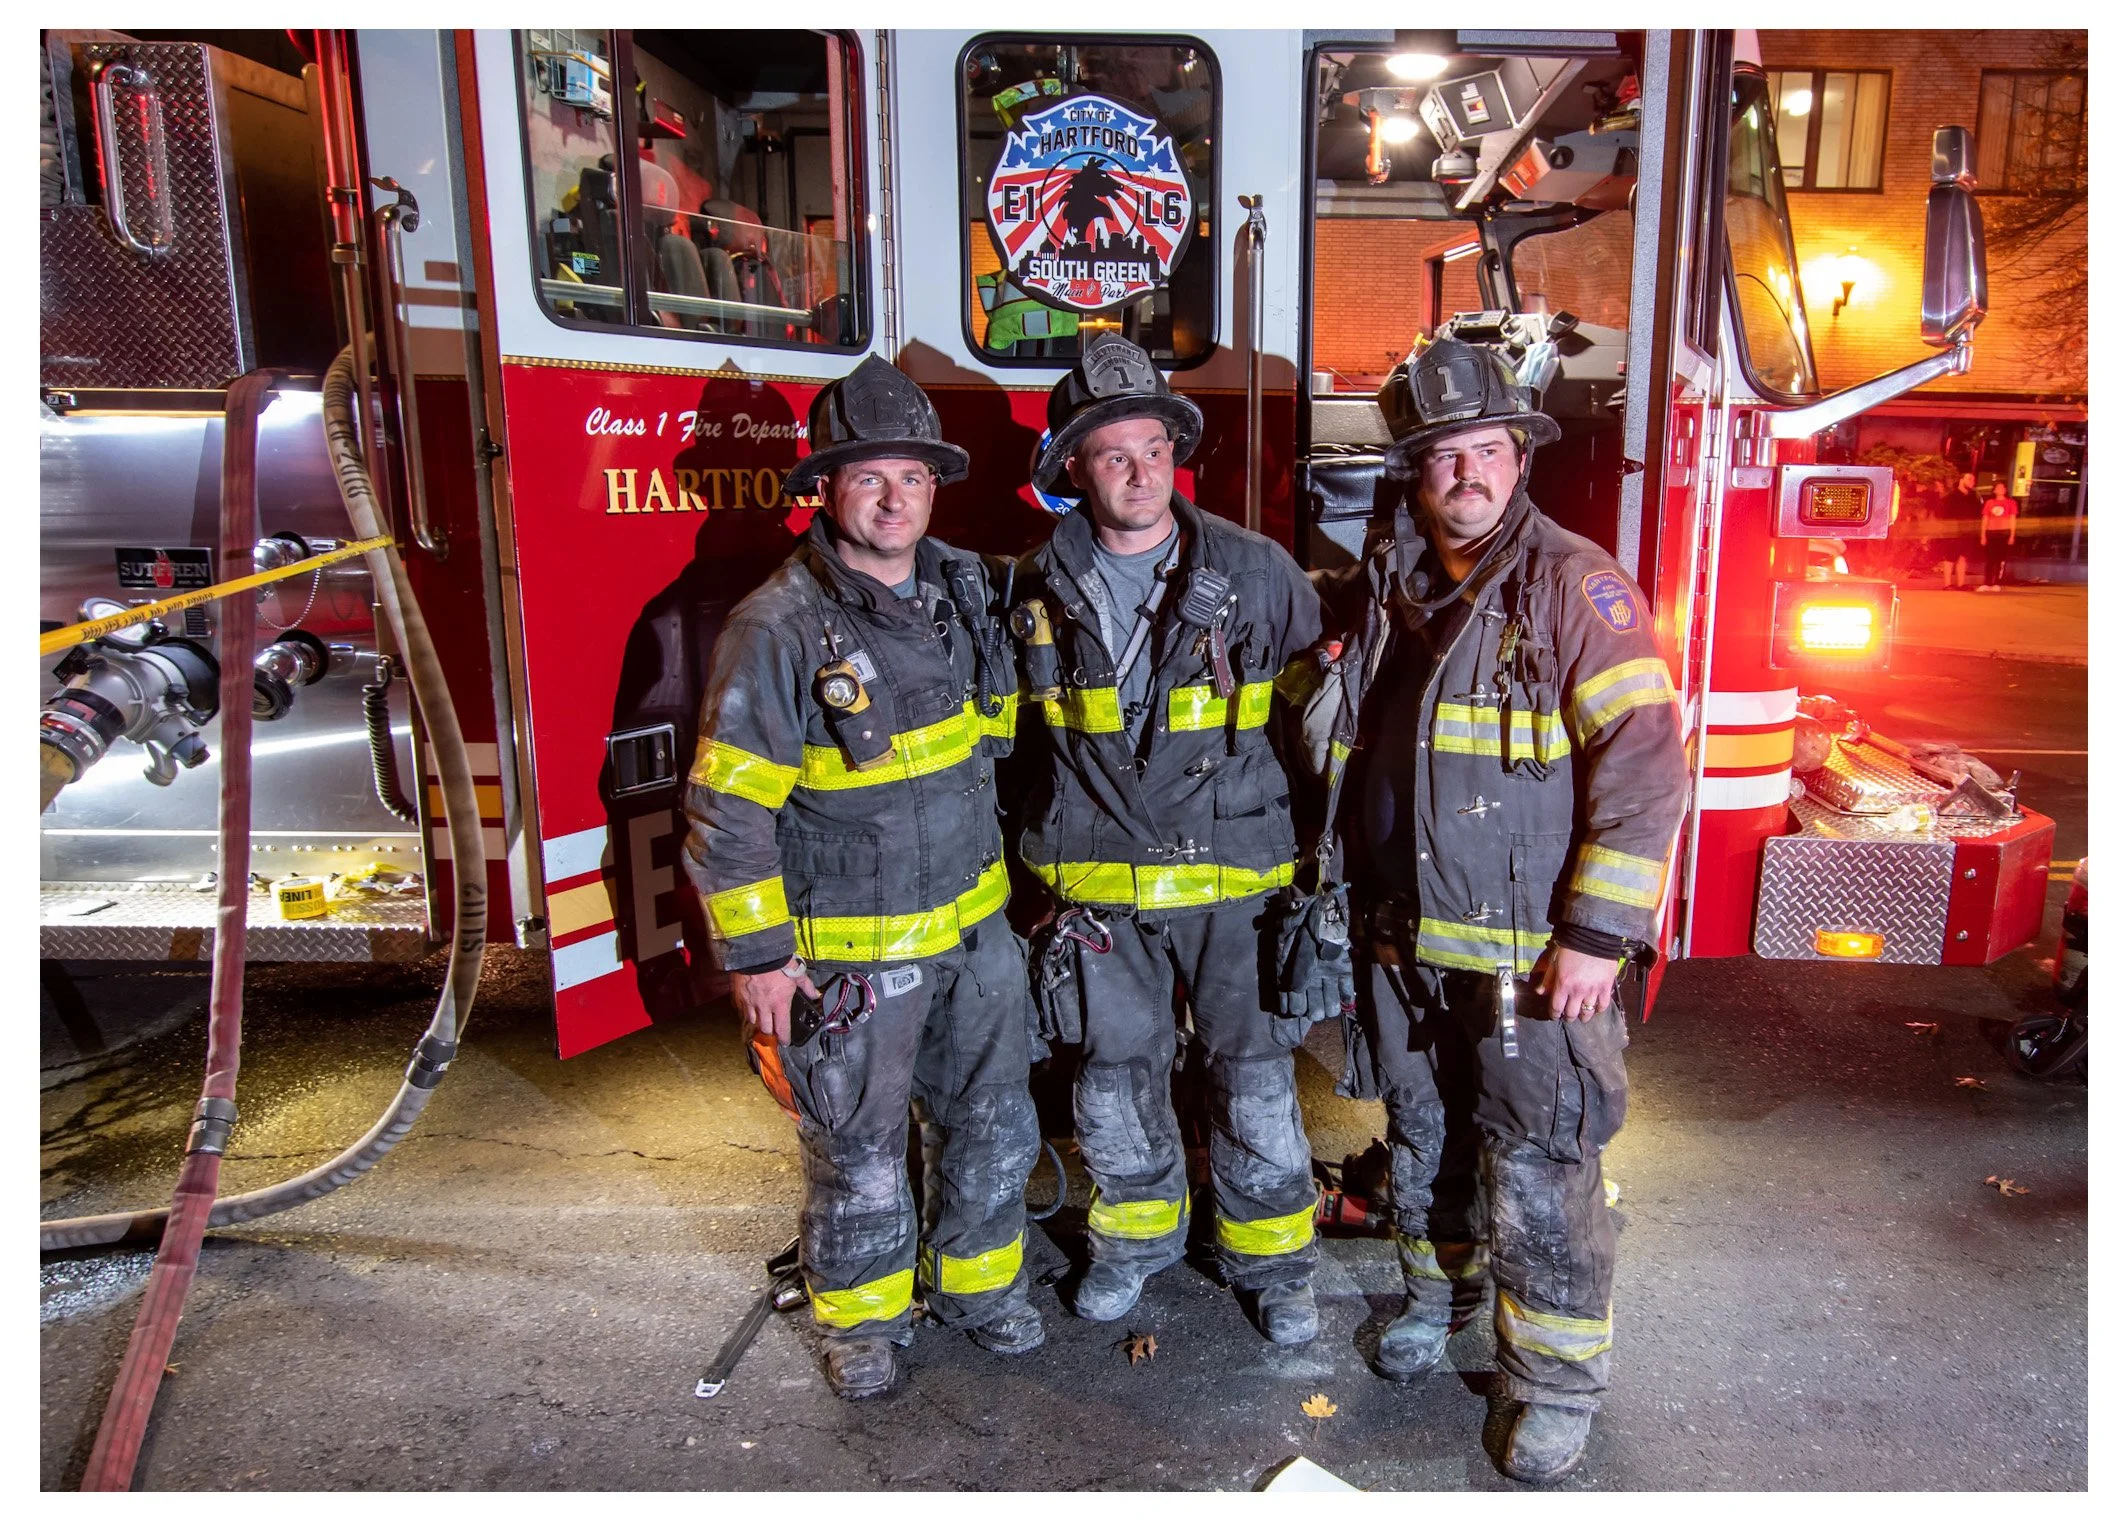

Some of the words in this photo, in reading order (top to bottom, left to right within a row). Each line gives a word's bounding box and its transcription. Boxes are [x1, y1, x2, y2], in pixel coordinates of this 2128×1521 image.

[1070, 110, 1093, 122] CITY
[1098, 111, 1111, 122] OF
[1040, 126, 1138, 158] HARTFORD
[1003, 186, 1034, 222] E1
[1144, 191, 1183, 226] L6
[1029, 259, 1090, 282] SOUTH
[1093, 260, 1150, 282] GREEN
[1052, 282, 1084, 300] Main
[1100, 282, 1130, 299] Park
[1091, 345, 1137, 362] LIEUTENANT
[1113, 366, 1134, 389] 1
[1437, 366, 1463, 403] 1
[585, 407, 646, 436] Class
[656, 412, 668, 437] 1
[677, 411, 723, 442] Fire
[732, 413, 808, 444] Departm
[603, 468, 823, 515] HARTFO
[628, 809, 684, 962] E
